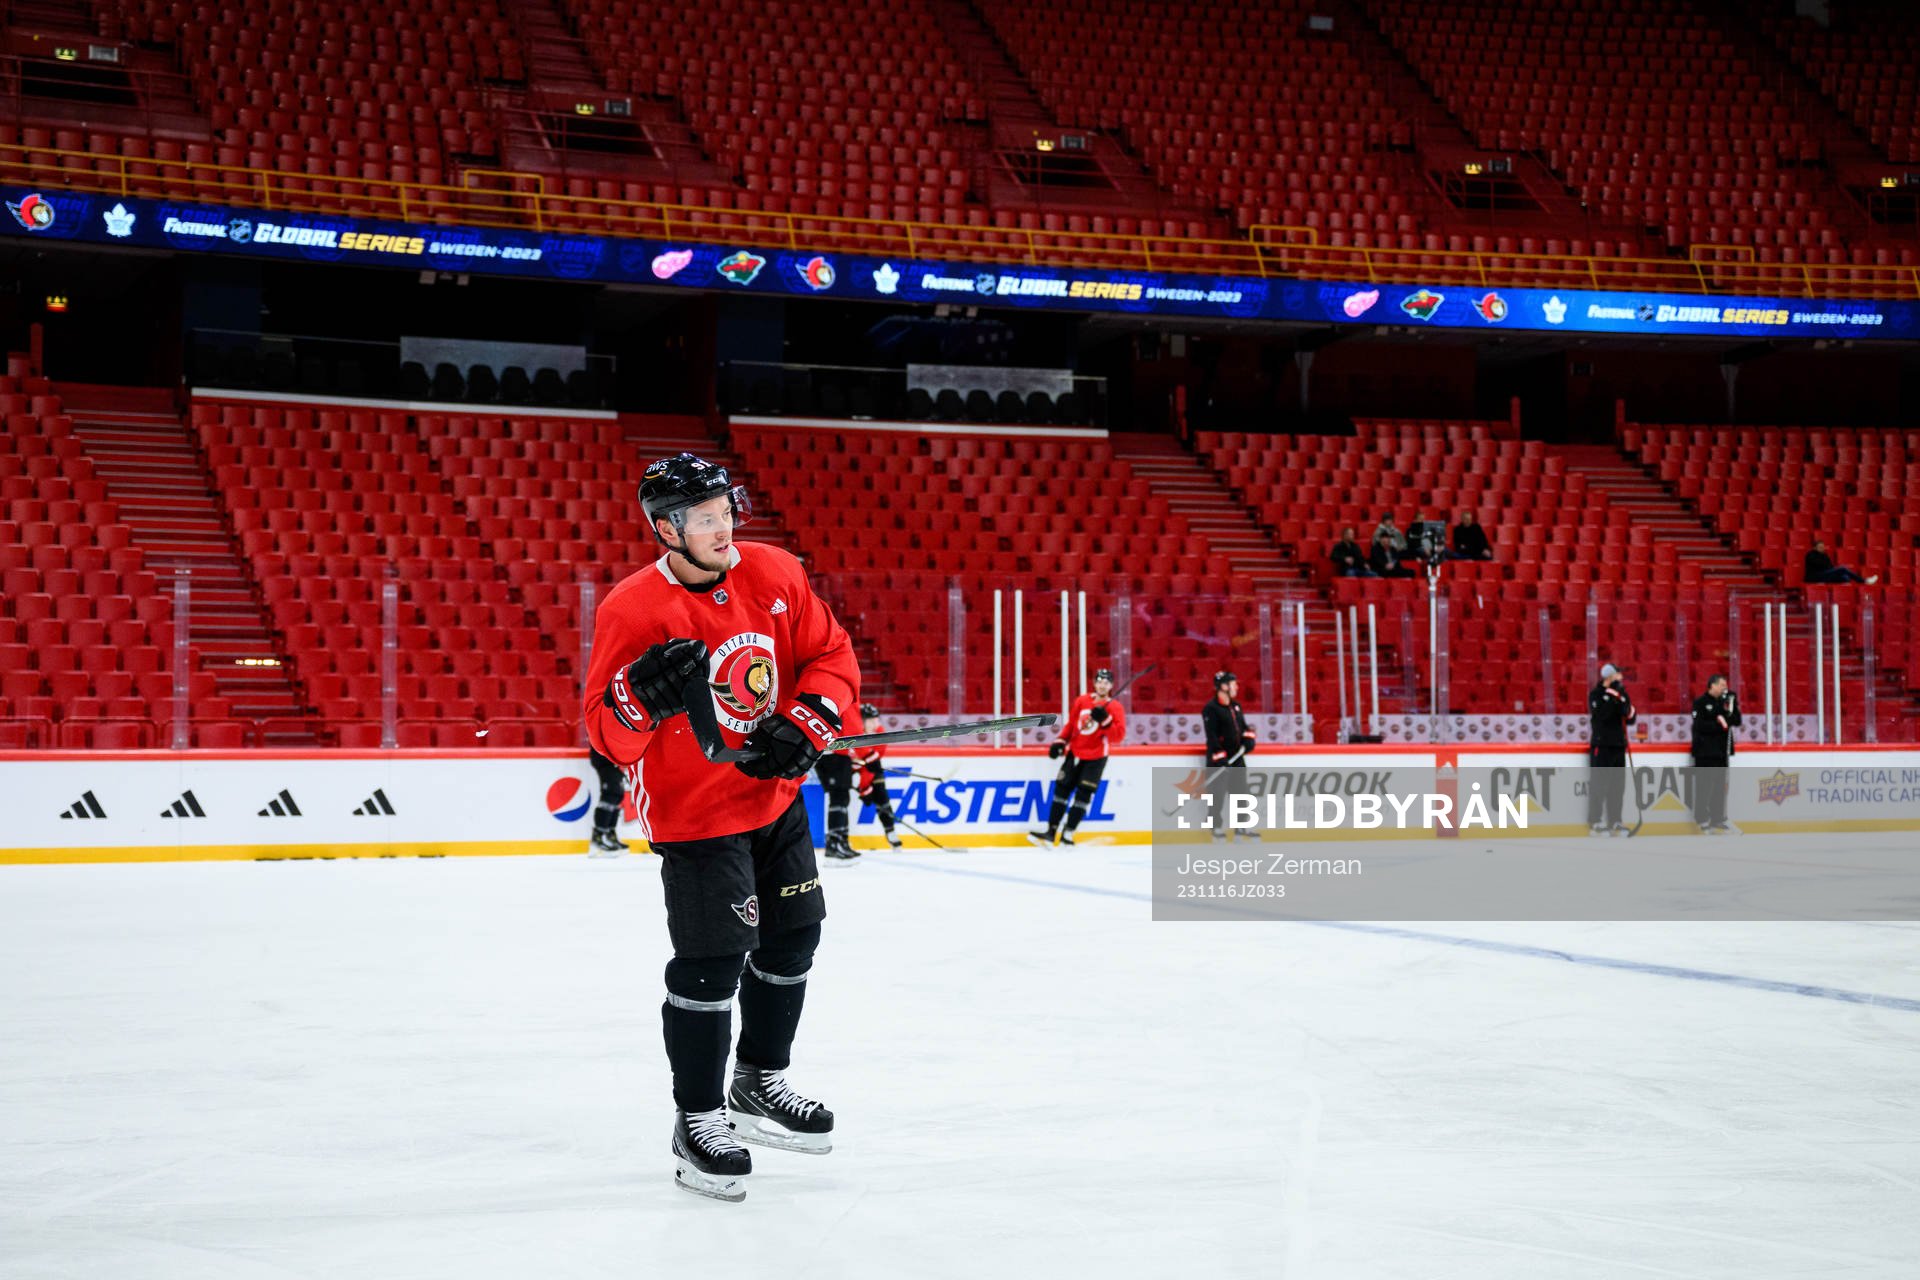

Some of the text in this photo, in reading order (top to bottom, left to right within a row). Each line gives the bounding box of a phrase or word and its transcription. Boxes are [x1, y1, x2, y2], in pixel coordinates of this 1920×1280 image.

[253, 222, 338, 248] GLOBAL
[338, 231, 425, 255] SERIES
[996, 275, 1068, 298] GLOBAL
[1068, 281, 1143, 300] SERIES
[1655, 305, 1721, 323] GLOBAL
[1722, 308, 1790, 325] SERIES
[717, 633, 758, 657] OTTAWA
[1490, 766, 1556, 812] CAT
[1820, 769, 1897, 785] OFFICIAL
[857, 766, 1116, 823] FASTENL
[1806, 788, 1884, 803] TRADING
